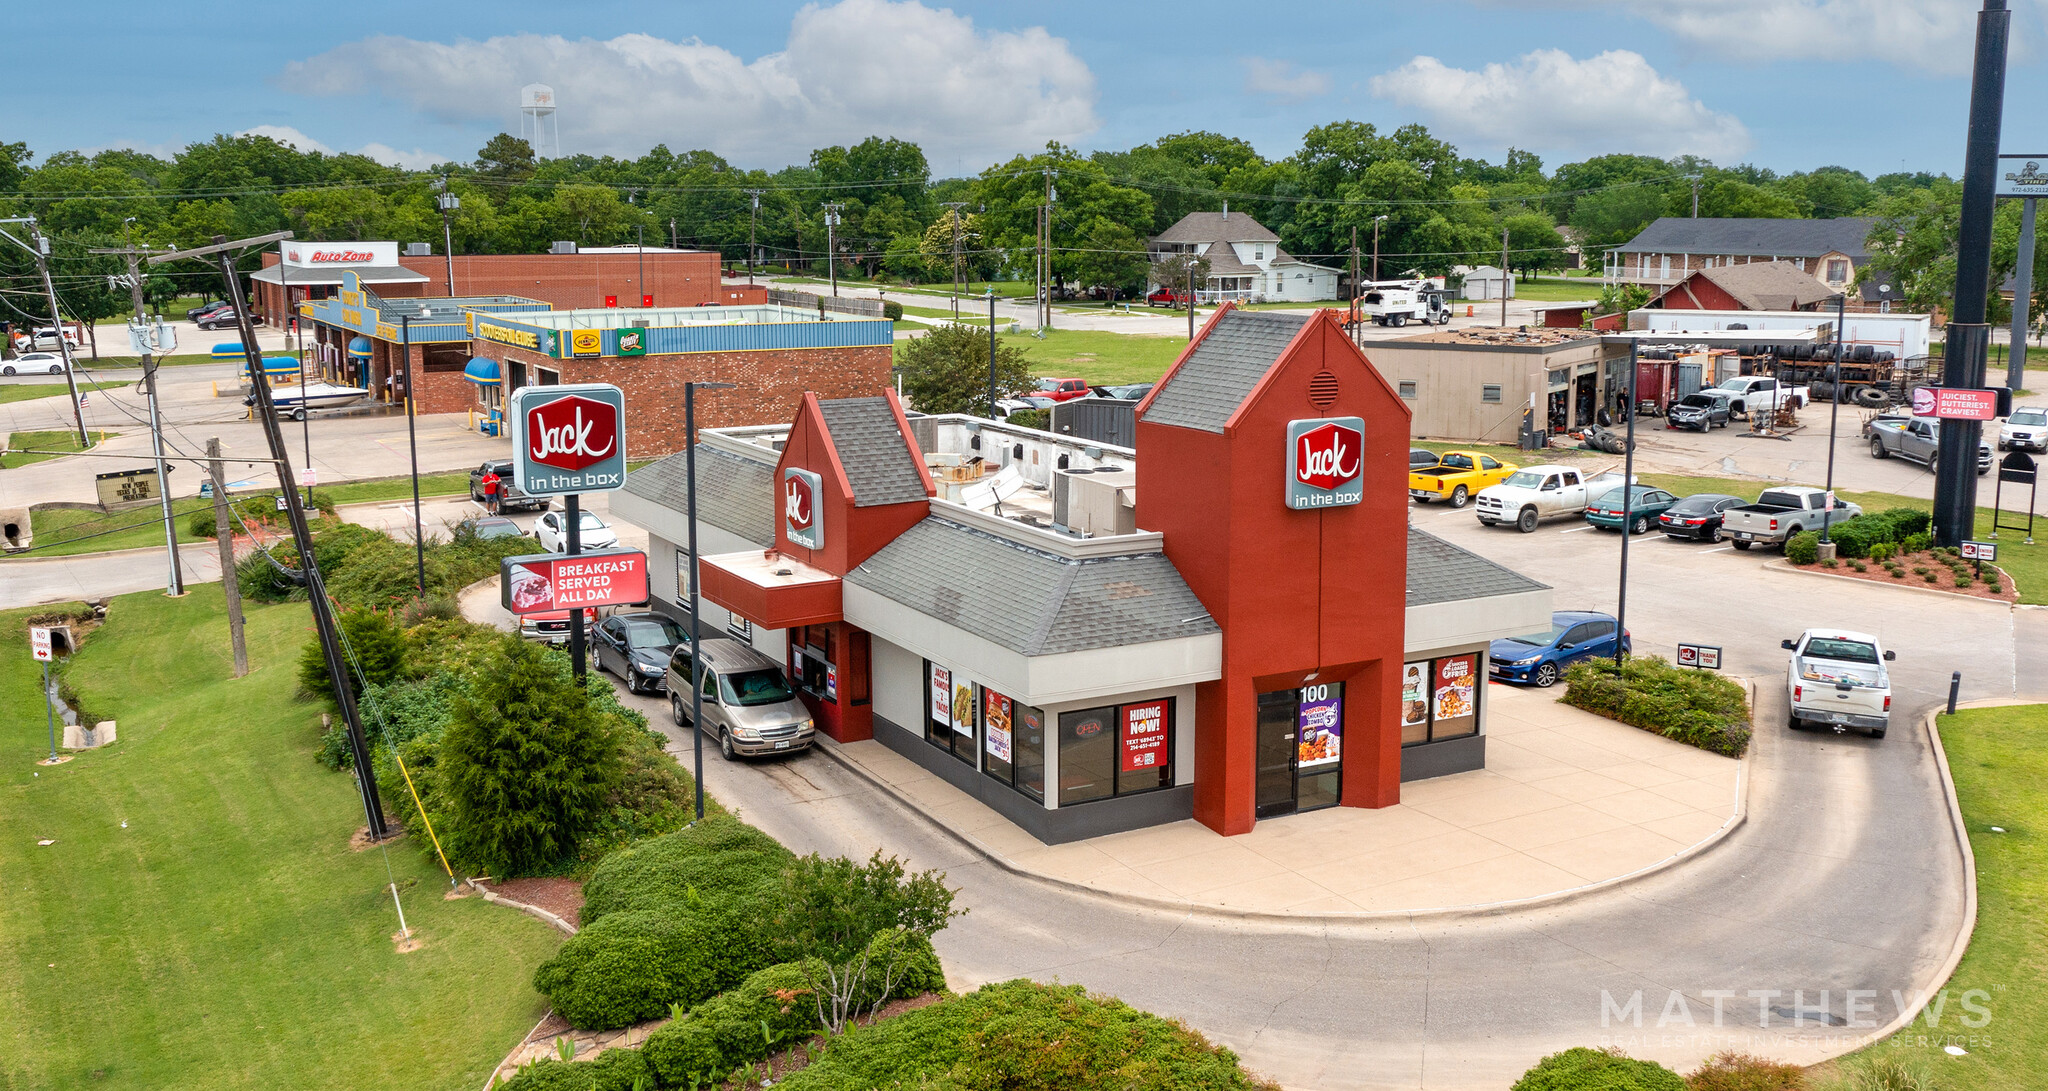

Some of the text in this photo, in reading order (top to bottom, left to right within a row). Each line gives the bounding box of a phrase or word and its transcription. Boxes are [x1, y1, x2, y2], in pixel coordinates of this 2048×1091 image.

[310, 250, 374, 263] AutoZone
[1941, 392, 1978, 402] JUICIEST.
[1940, 407, 1981, 417] CRAVIEST.
[1941, 400, 1990, 410] BUTTERIEST.
[533, 406, 614, 459] Jack
[1299, 431, 1359, 480] Jack
[530, 473, 619, 490] in the box
[1295, 491, 1361, 507] in the box
[793, 531, 803, 544] the
[803, 534, 815, 548] box
[558, 560, 635, 577] BREAKFAST
[558, 575, 611, 590] SERVED
[559, 588, 613, 604] ALL DAY
[36, 631, 46, 640] NO
[33, 640, 51, 650] PARKING
[934, 667, 948, 681] JACK'S
[1451, 669, 1468, 678] FRIES
[1300, 684, 1328, 703] 100
[935, 701, 948, 714] TACOS
[1129, 706, 1160, 722] HIRING
[1305, 706, 1327, 716] POPCORN
[1076, 722, 1100, 735] OPEN
[1130, 718, 1160, 735] NOW!
[1126, 738, 1139, 746] TEXT
